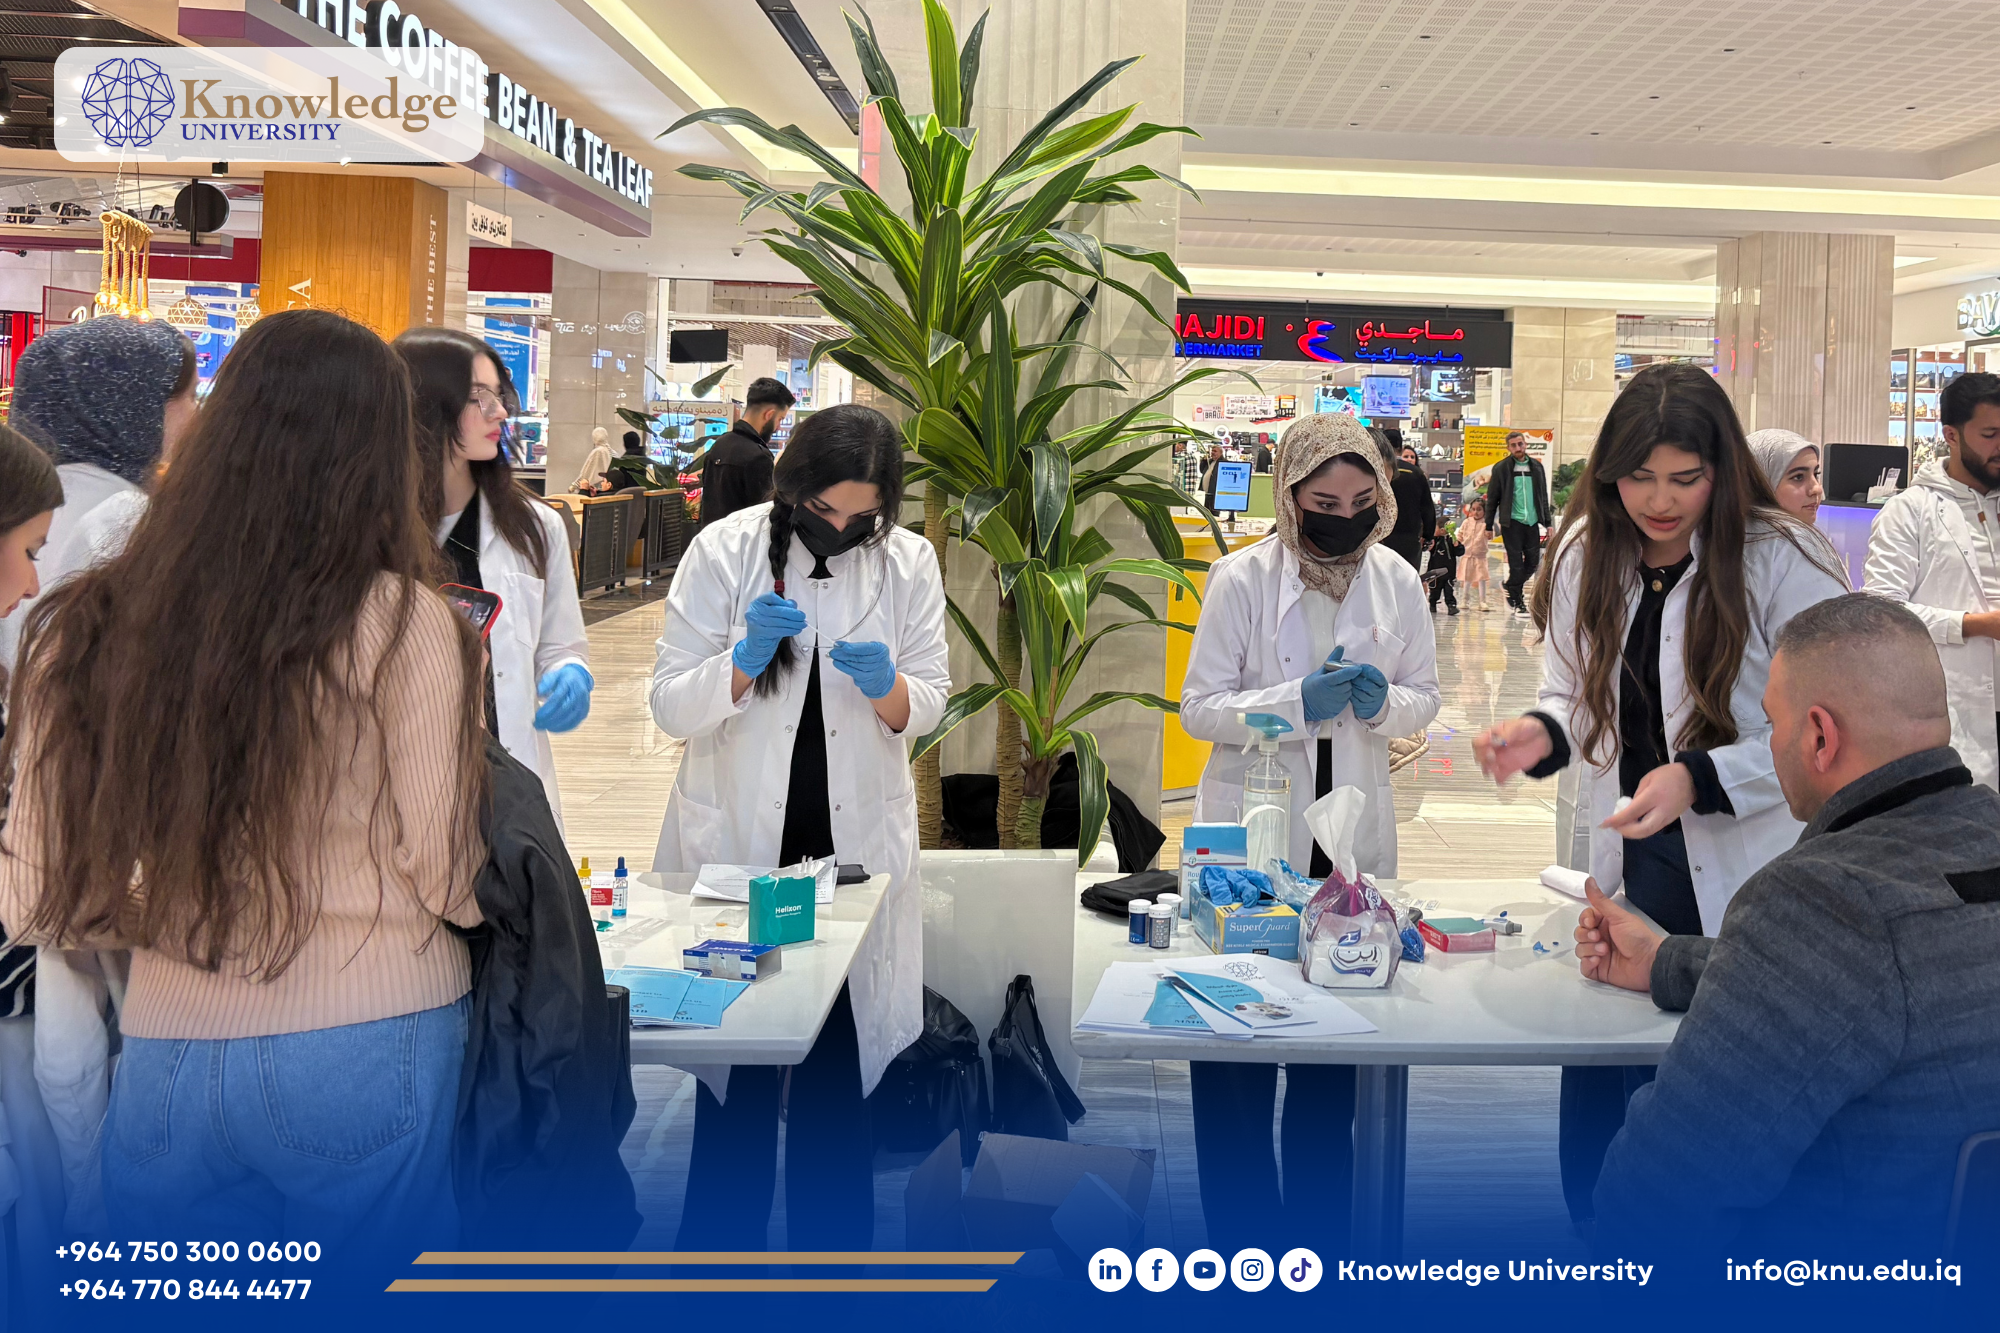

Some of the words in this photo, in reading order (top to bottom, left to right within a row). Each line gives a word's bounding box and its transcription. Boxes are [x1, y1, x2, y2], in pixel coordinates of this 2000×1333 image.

[298, 0, 367, 51] HE
[379, 0, 490, 119] COFFEE
[498, 73, 557, 156] BEAN
[563, 118, 577, 168] &
[583, 128, 614, 189] TEA
[618, 152, 652, 209] LEAF
[428, 214, 437, 274] BEST
[426, 279, 435, 323] THE
[1355, 319, 1465, 347] ماجدي
[1354, 347, 1464, 363] هايبرماركيت
[1205, 410, 1225, 419] BRAU
[775, 905, 802, 915] Helixon
